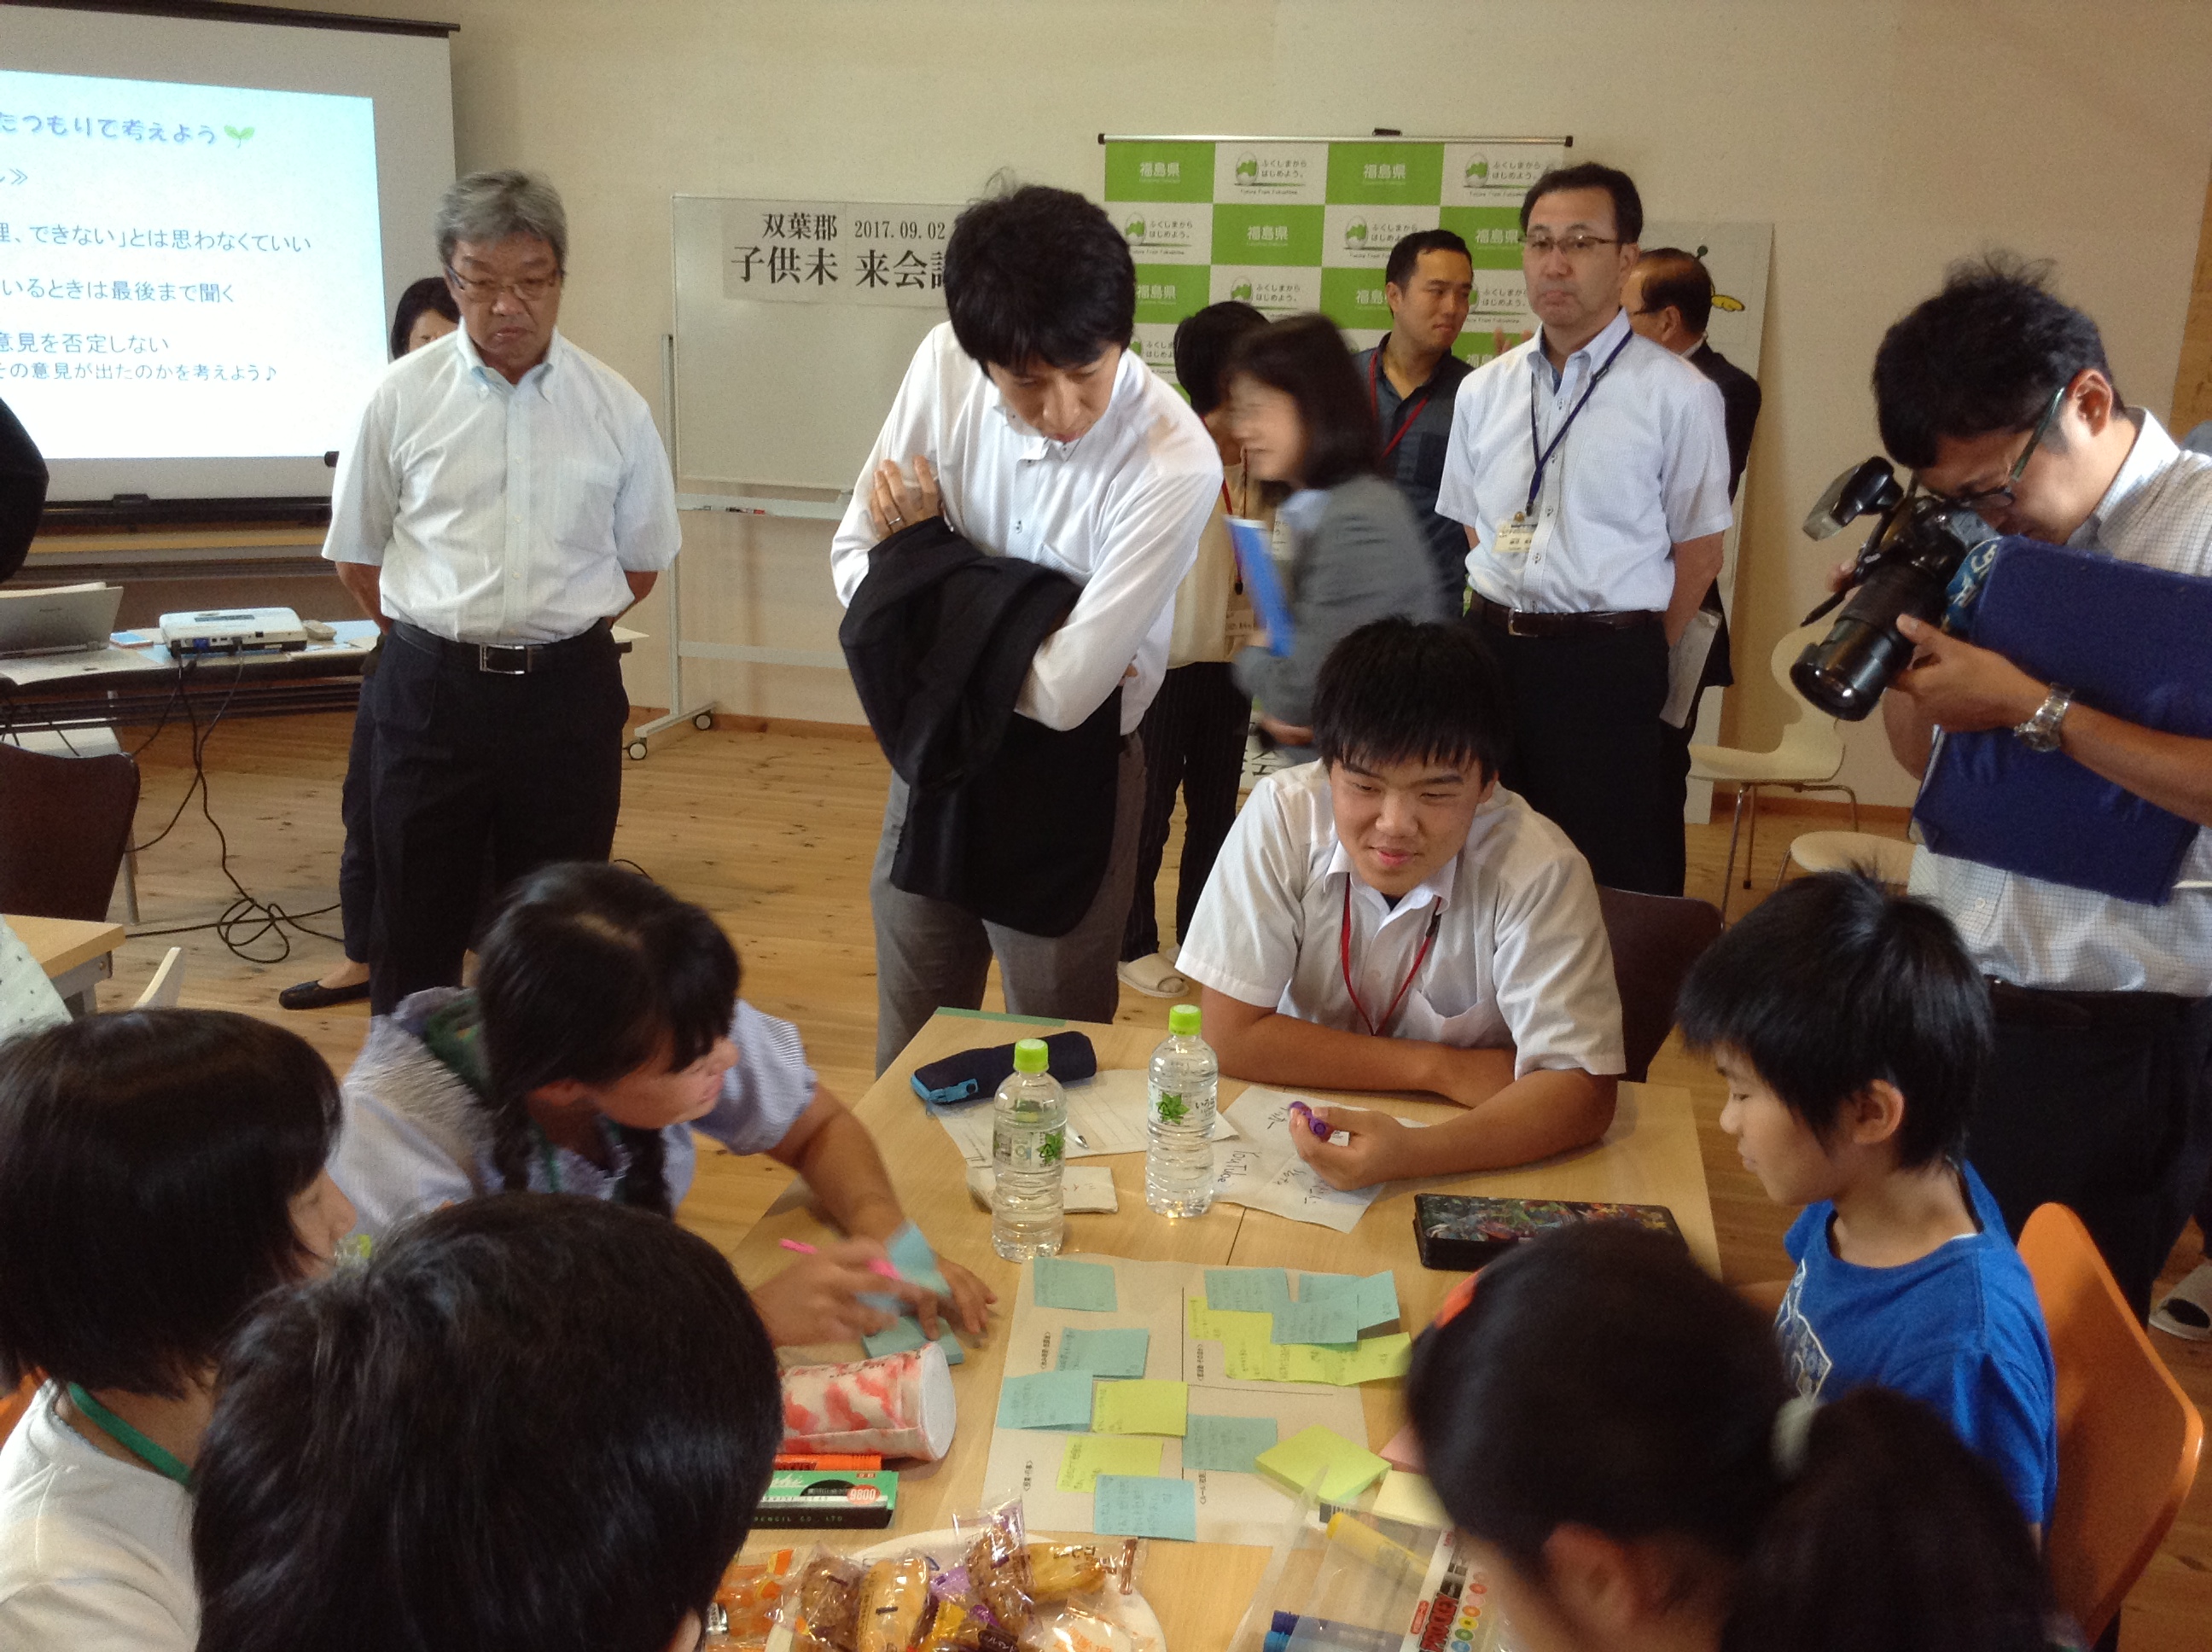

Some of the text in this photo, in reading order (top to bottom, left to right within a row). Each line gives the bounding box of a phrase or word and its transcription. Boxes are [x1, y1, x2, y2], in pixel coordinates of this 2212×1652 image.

[1138, 161, 1180, 177] 福島県
[1261, 159, 1307, 168] ふくしまから
[1364, 163, 1406, 179] 福島県
[1493, 161, 1541, 170] ふくしまから
[762, 212, 946, 241] 双葉郡 2017.09.02
[1150, 220, 1193, 229] ふくしまから
[1247, 225, 1289, 241] 福島県
[1475, 228, 1519, 244] 福島県
[2, 278, 234, 303] いるときは最後まで聞く
[1137, 284, 1176, 300] 福島県
[1256, 283, 1301, 292] ふくしまから
[1355, 289, 1387, 305] 福島
[0, 332, 169, 353] 意見を否定しない
[851, 1488, 876, 1500] 9800
